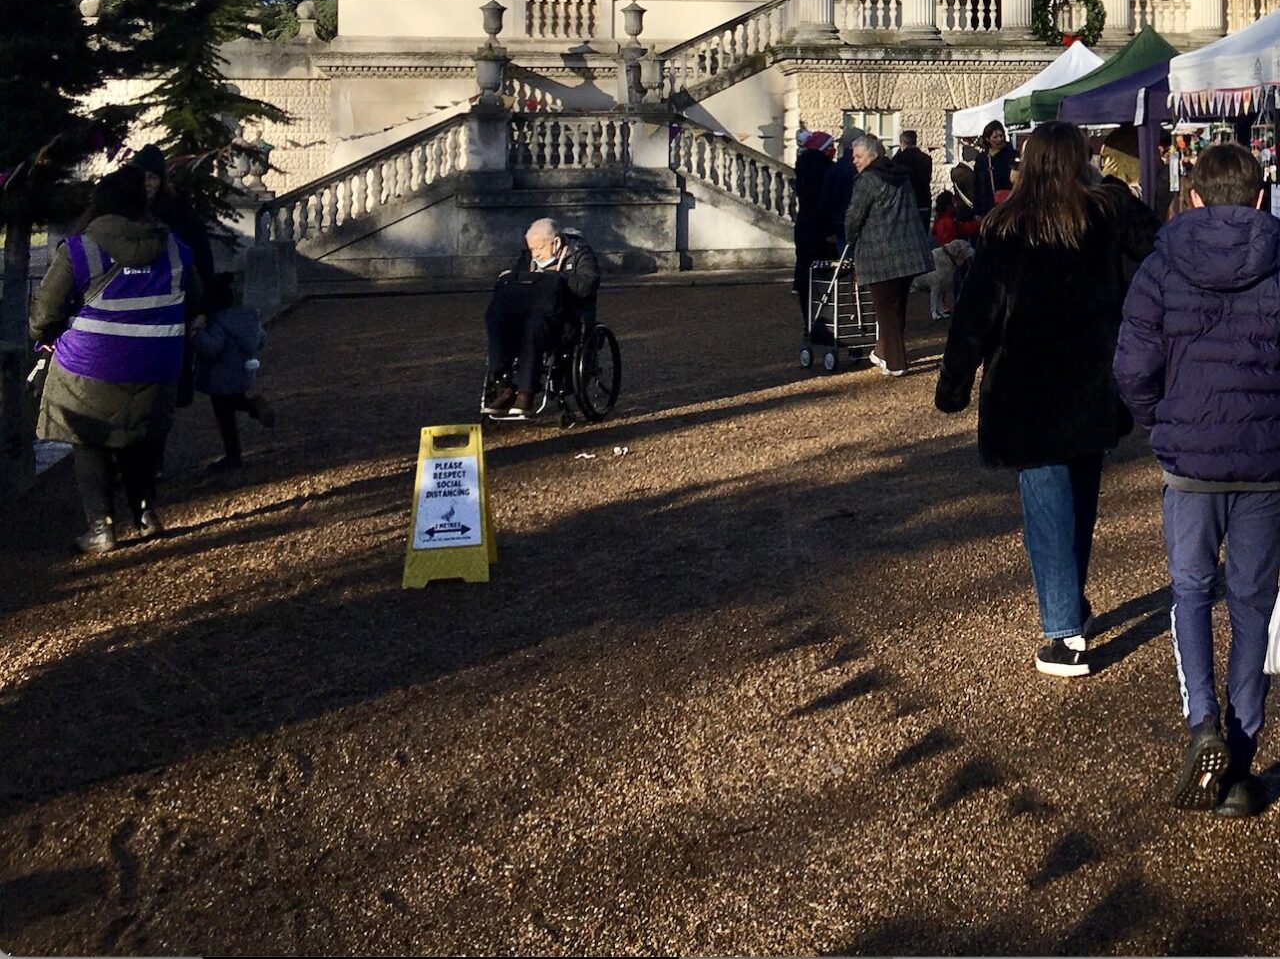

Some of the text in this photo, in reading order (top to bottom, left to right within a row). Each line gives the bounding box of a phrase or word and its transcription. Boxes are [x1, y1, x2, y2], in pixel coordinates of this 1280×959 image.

[435, 462, 463, 470] PLEASE
[433, 471, 466, 479] RESPECT
[437, 480, 462, 488] SOCIAL
[426, 488, 470, 498] DISTANCING
